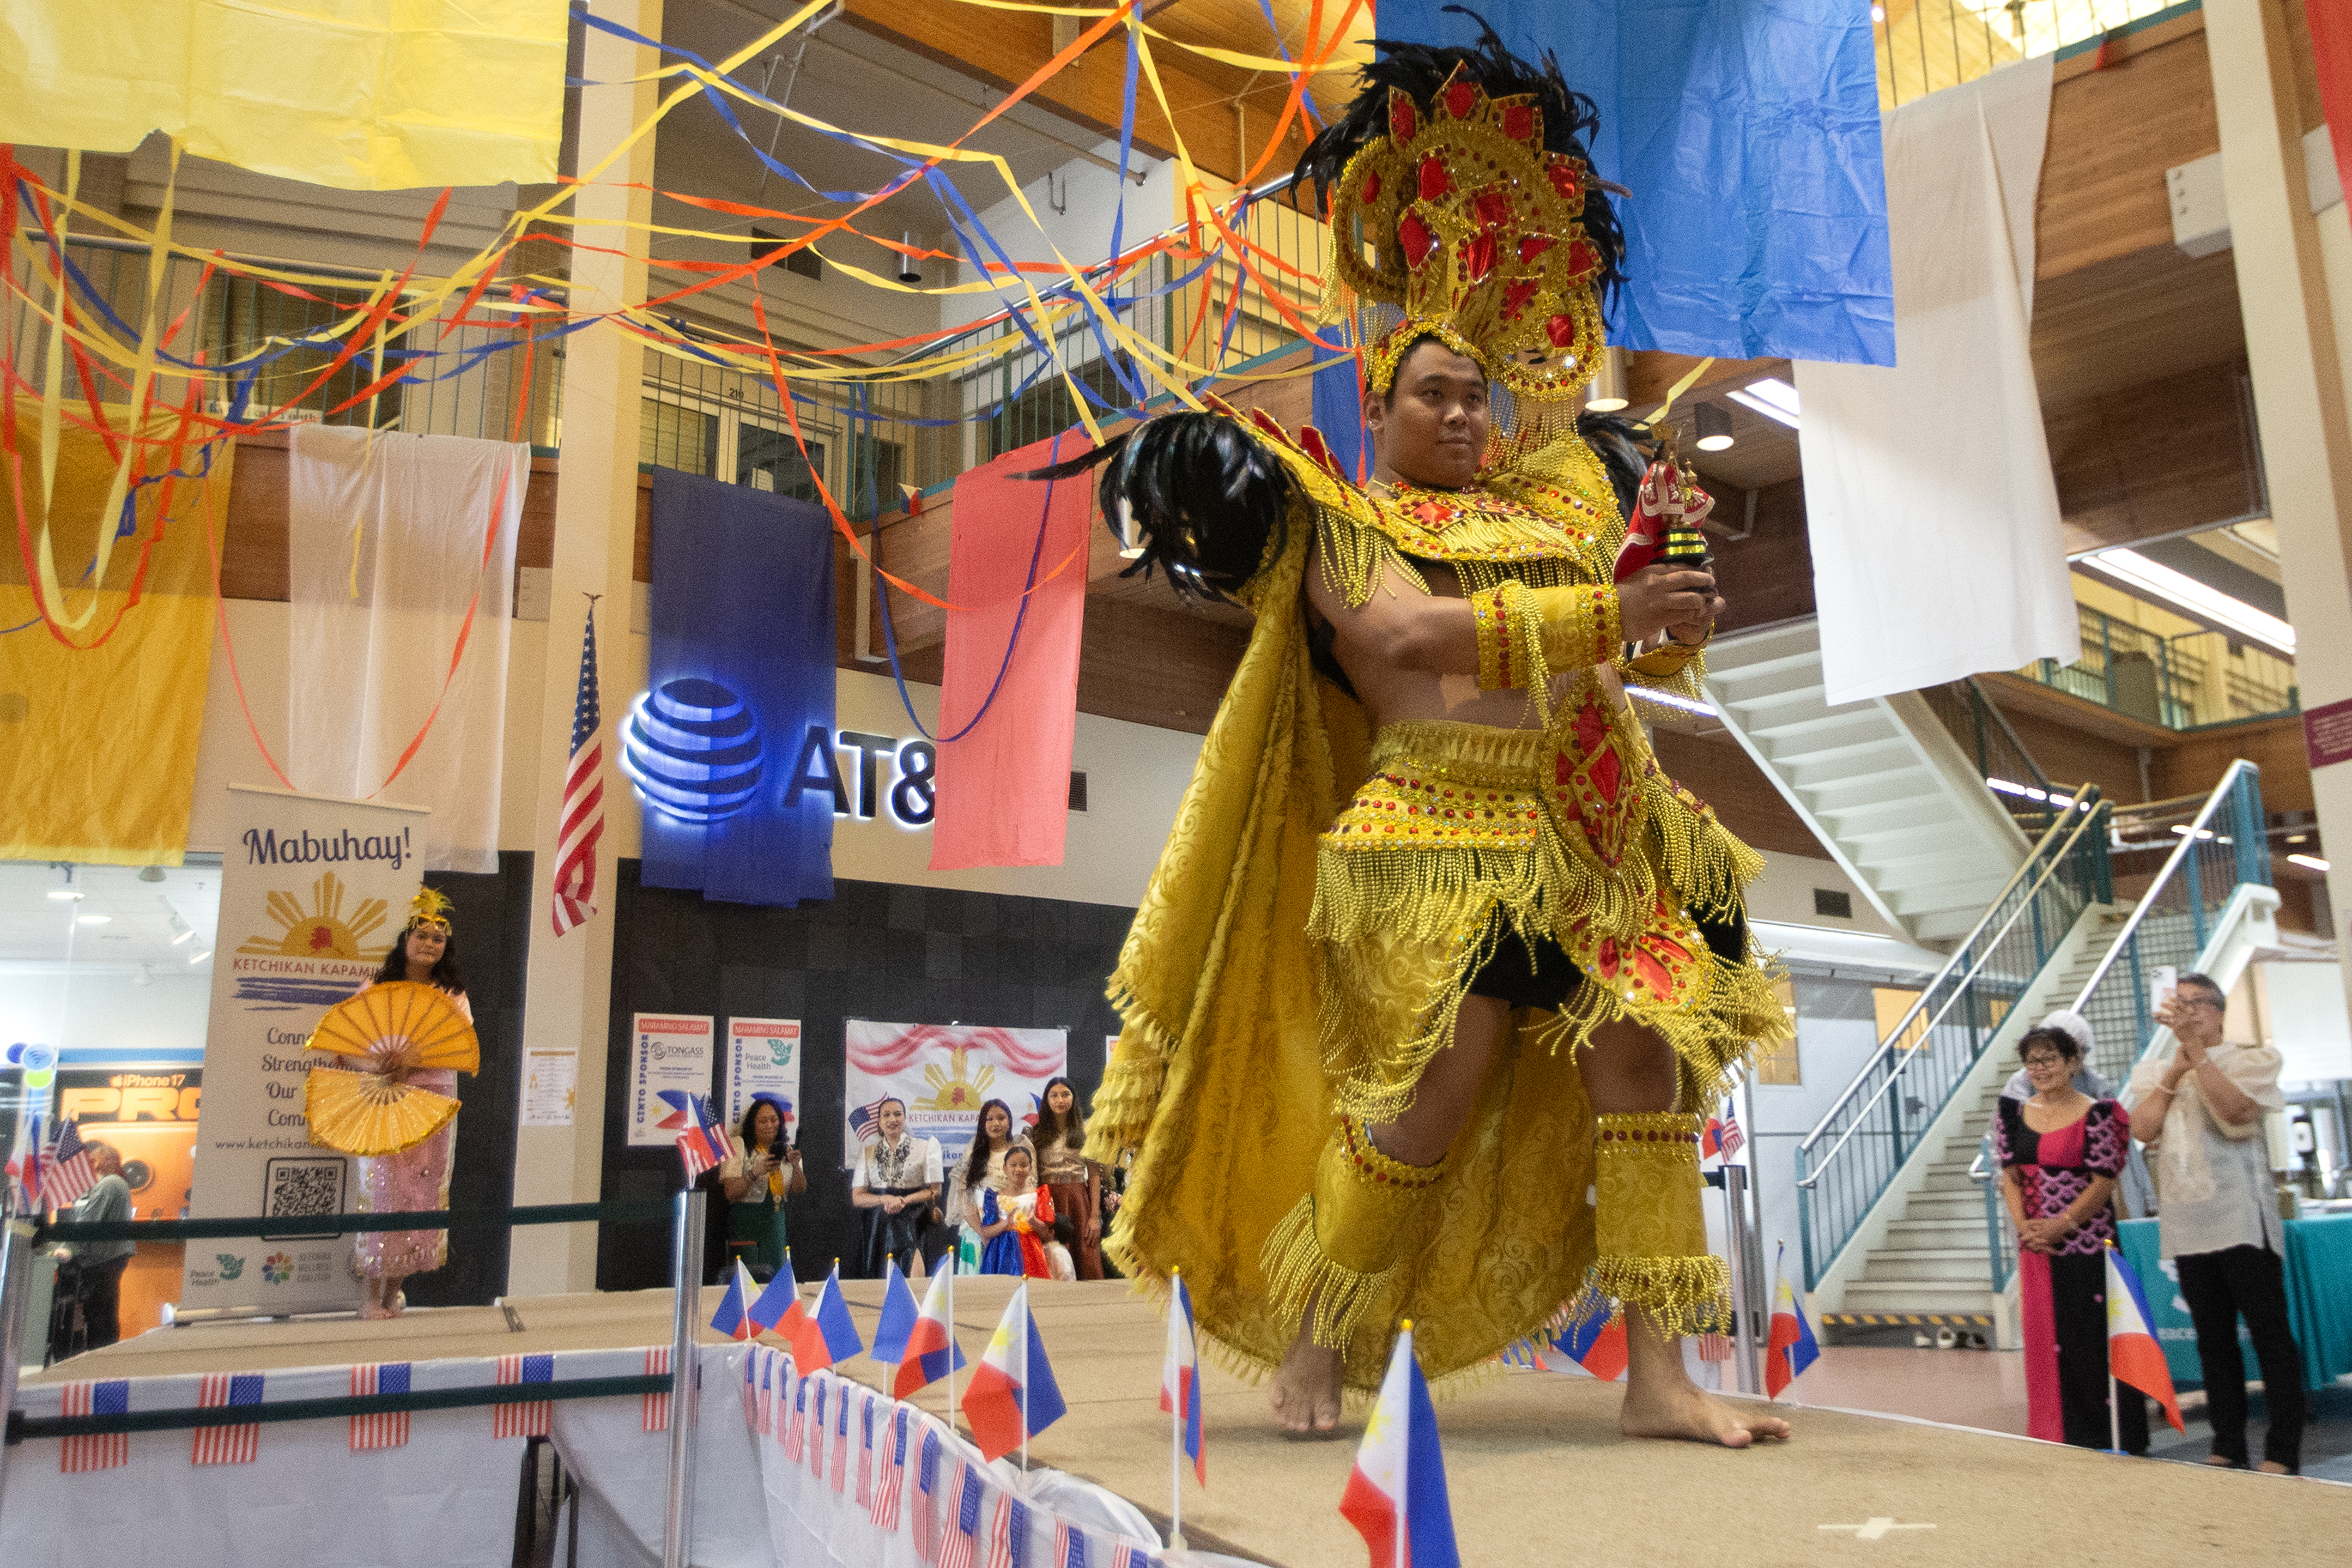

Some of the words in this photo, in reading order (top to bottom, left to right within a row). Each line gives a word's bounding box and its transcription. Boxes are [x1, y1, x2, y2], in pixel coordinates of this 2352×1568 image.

[729, 388, 744, 399] 210
[785, 726, 935, 825] AT&
[242, 827, 412, 870] Mabuhay!
[233, 958, 314, 974] KETCHIKAN
[321, 963, 378, 978] KAPAMI
[267, 1027, 312, 1045] Conn
[639, 1034, 649, 1084] SPONSOR
[666, 1046, 704, 1056] TONGASS
[745, 1053, 767, 1061] Peace
[734, 1038, 743, 1087] SPONSOR
[123, 1074, 170, 1087] iPhone
[171, 1074, 186, 1087] 17
[266, 1081, 298, 1098] Our
[268, 1109, 306, 1127] Com
[909, 1114, 955, 1123] KETCHIKAN
[215, 1137, 312, 1150] www.ketchikan
